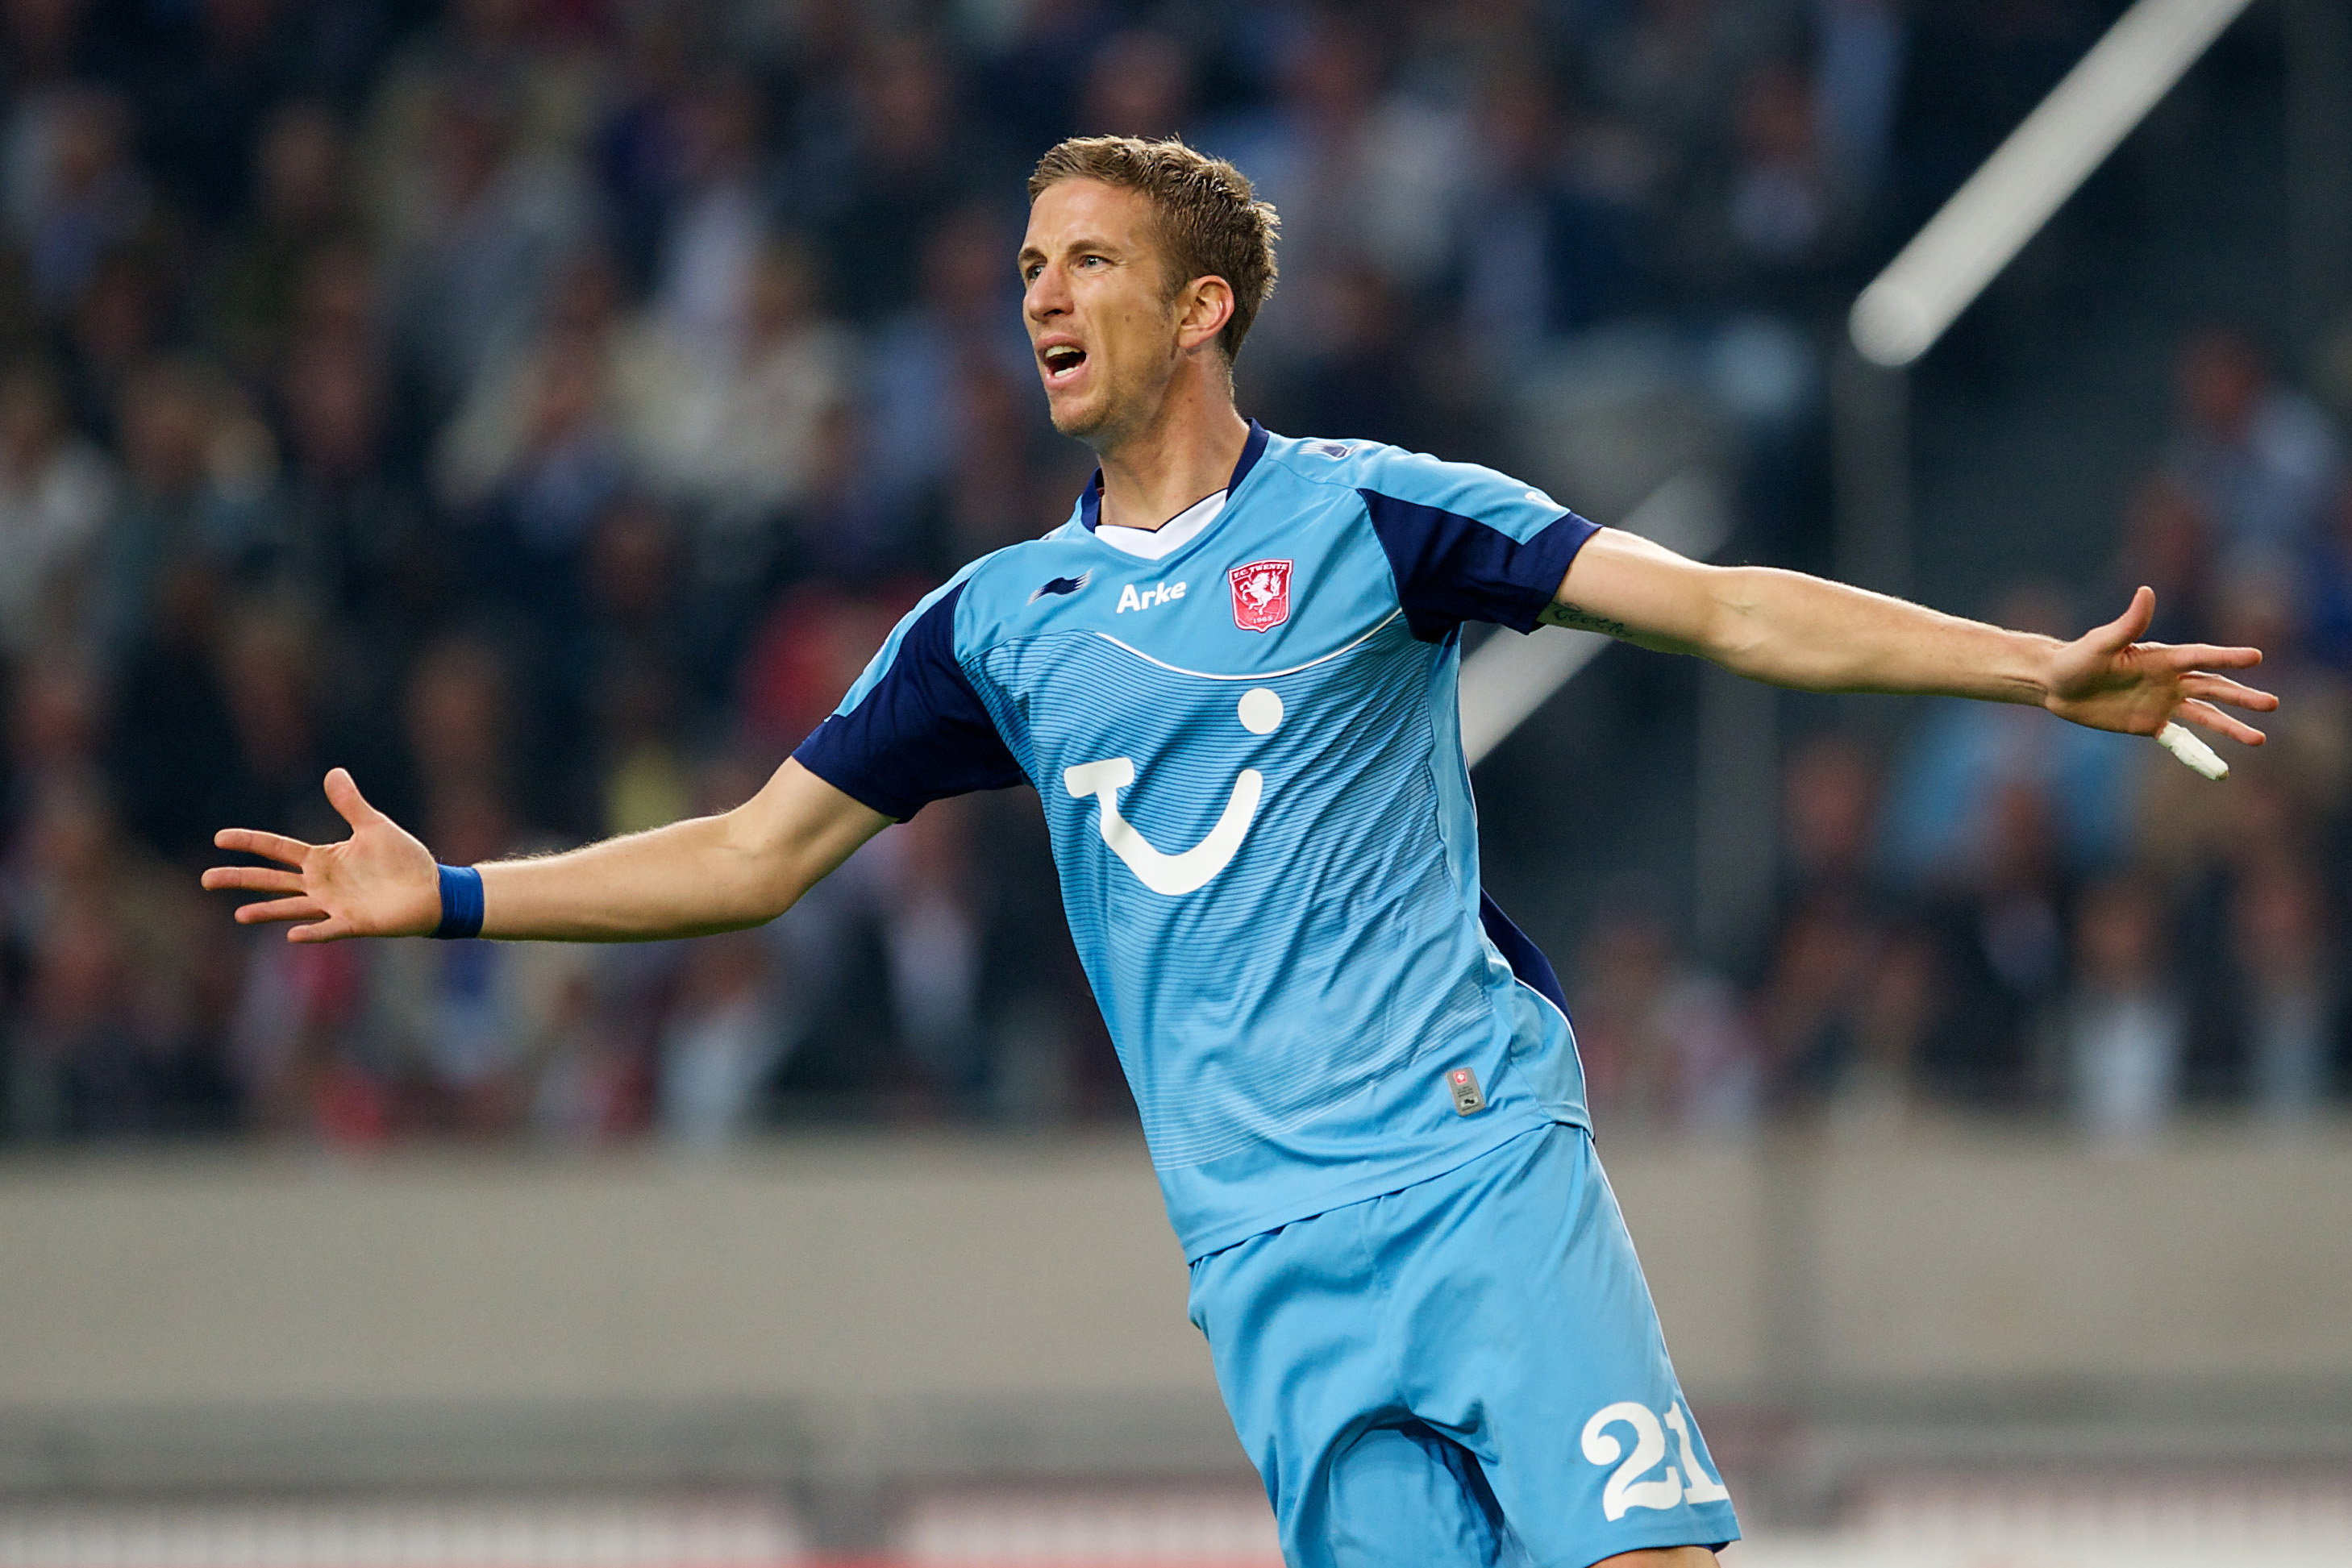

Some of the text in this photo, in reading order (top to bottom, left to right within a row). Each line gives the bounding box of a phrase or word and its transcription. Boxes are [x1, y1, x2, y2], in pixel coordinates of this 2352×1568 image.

[1249, 564, 1288, 573] TWENTE
[1117, 581, 1187, 613] Arke
[1581, 1401, 1730, 1522] 21
